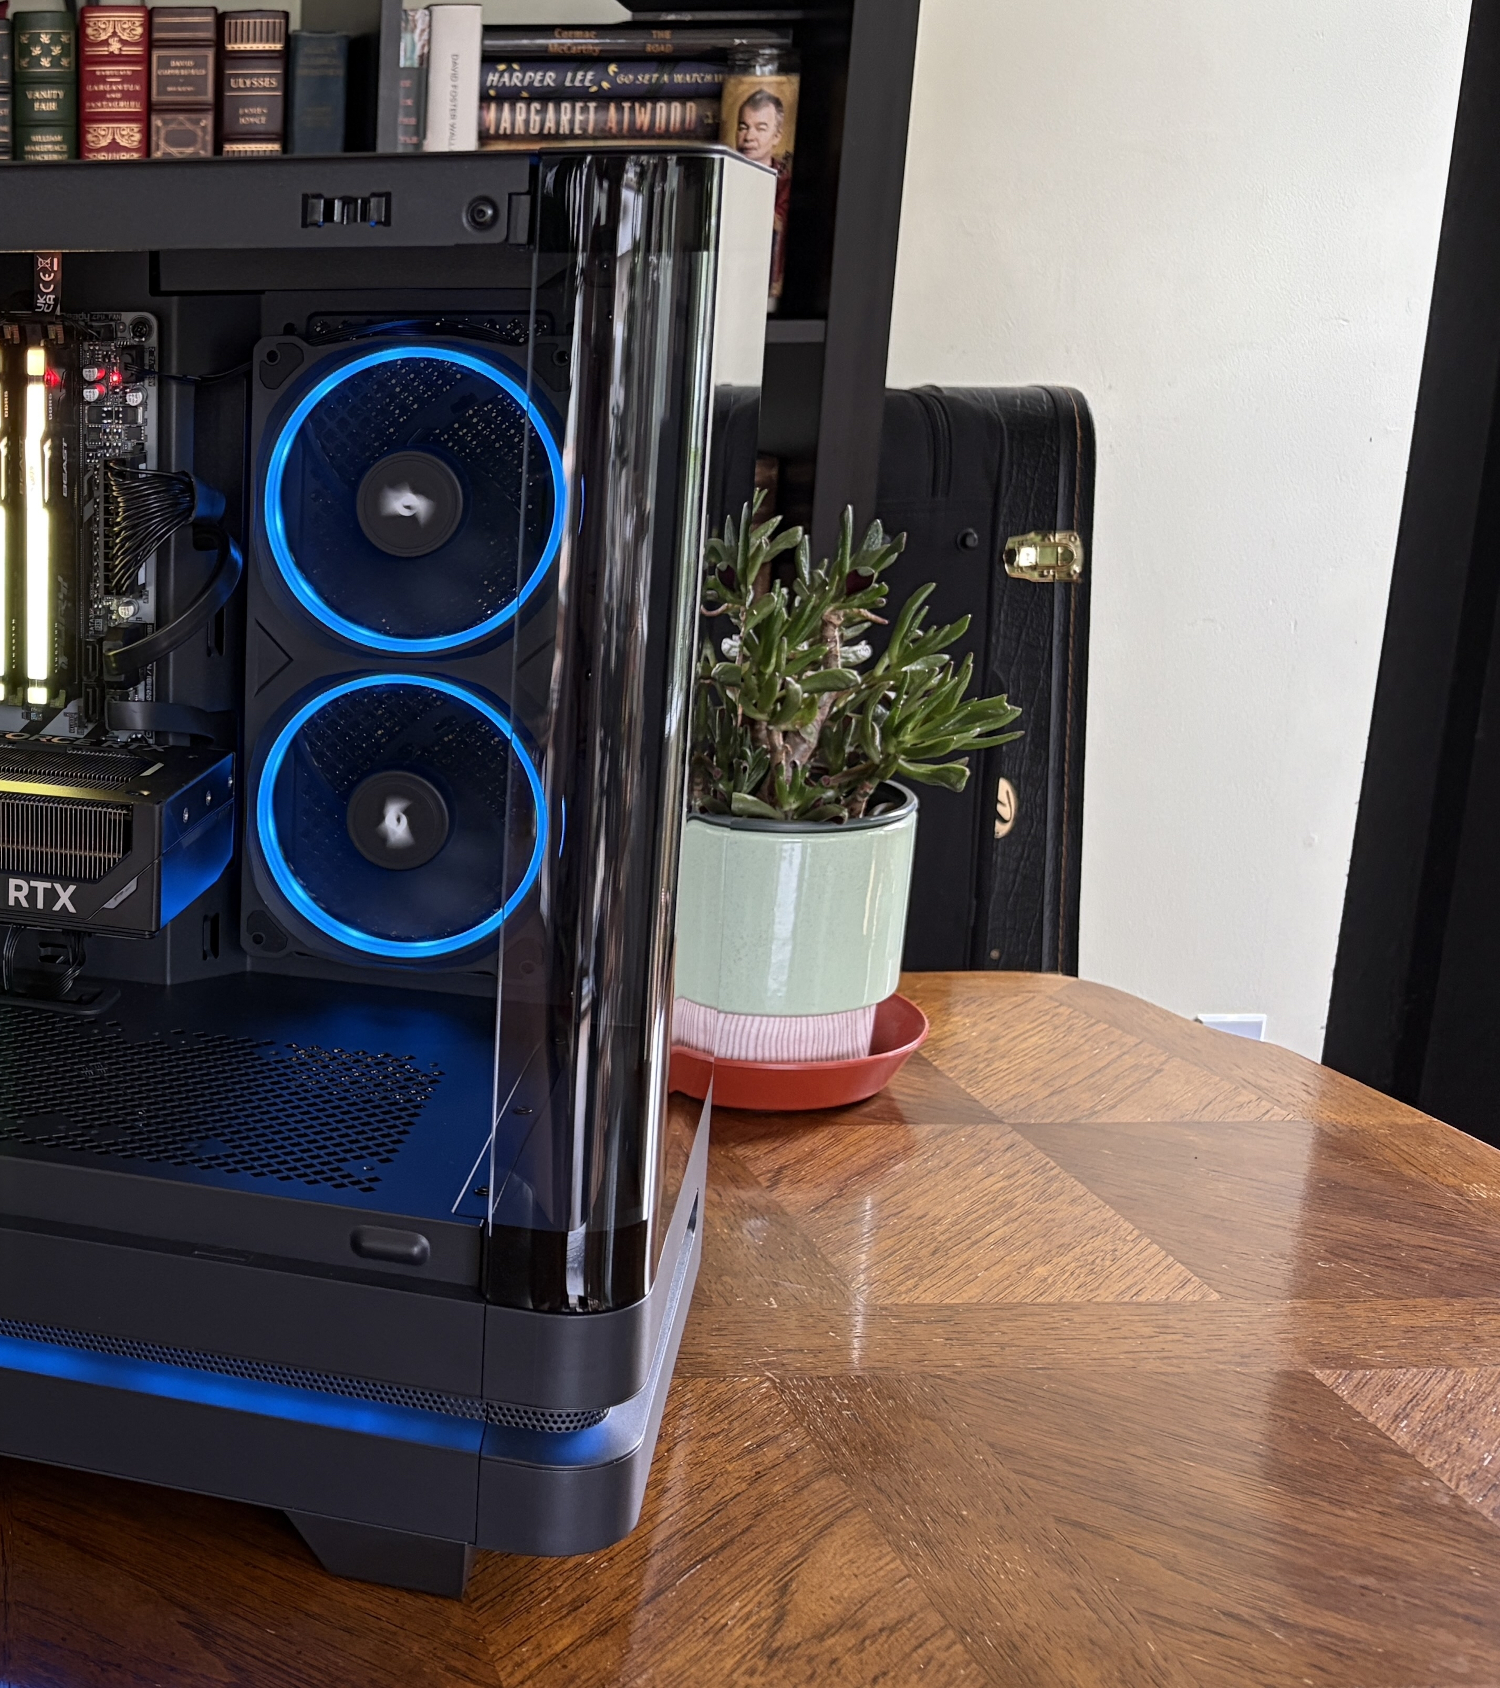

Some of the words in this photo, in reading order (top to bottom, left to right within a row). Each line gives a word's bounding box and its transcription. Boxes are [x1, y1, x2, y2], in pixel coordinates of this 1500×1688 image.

[554, 28, 597, 39] Cormac
[651, 30, 673, 39] THE
[547, 43, 601, 55] McCarthy
[645, 44, 674, 53] ROAD
[230, 78, 277, 88] ULYSSES
[486, 71, 556, 87] HARPER
[564, 71, 596, 87] LEE
[616, 73, 634, 84] GO
[635, 73, 659, 84] SET
[659, 74, 669, 83] A
[26, 90, 65, 99] VANITY
[34, 102, 58, 111] FAIR
[482, 102, 598, 135] MARGARET
[605, 102, 697, 135] ATWOOD
[449, 123, 457, 150] WALL
[101, 740, 170, 753] RTX
[8, 878, 78, 914] RTX
